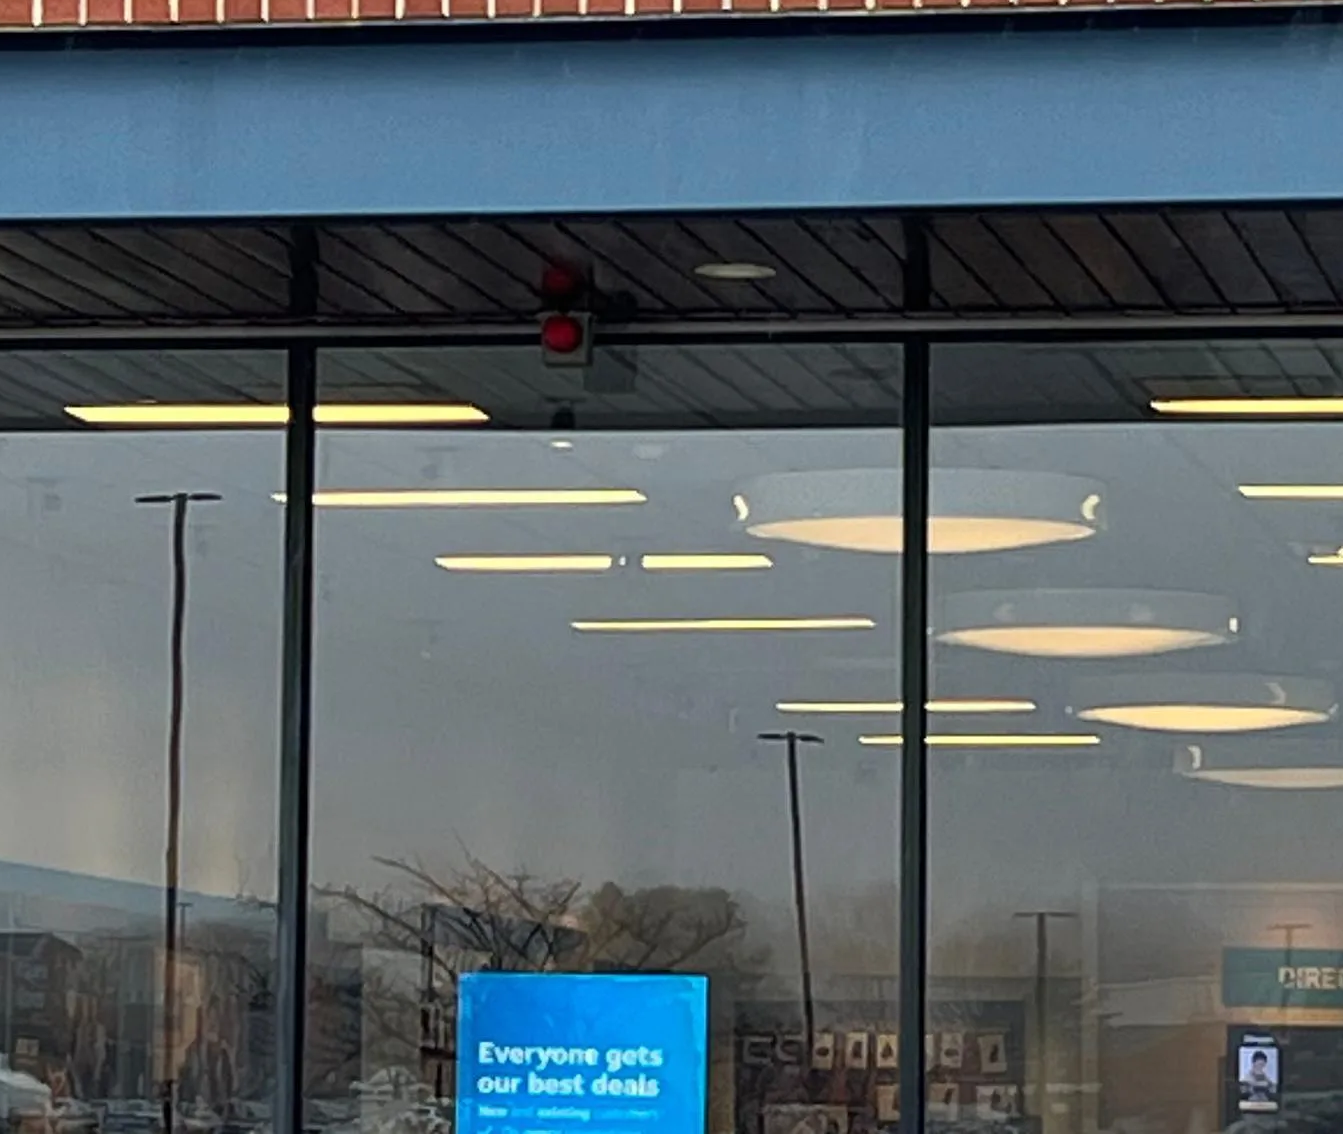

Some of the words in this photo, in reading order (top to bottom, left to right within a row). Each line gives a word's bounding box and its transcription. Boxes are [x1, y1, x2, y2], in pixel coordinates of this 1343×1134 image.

[478, 1041, 599, 1071] Everyone
[606, 1045, 664, 1072] gets
[477, 1075, 520, 1094] our
[527, 1071, 585, 1096] best
[591, 1072, 661, 1098] deals
